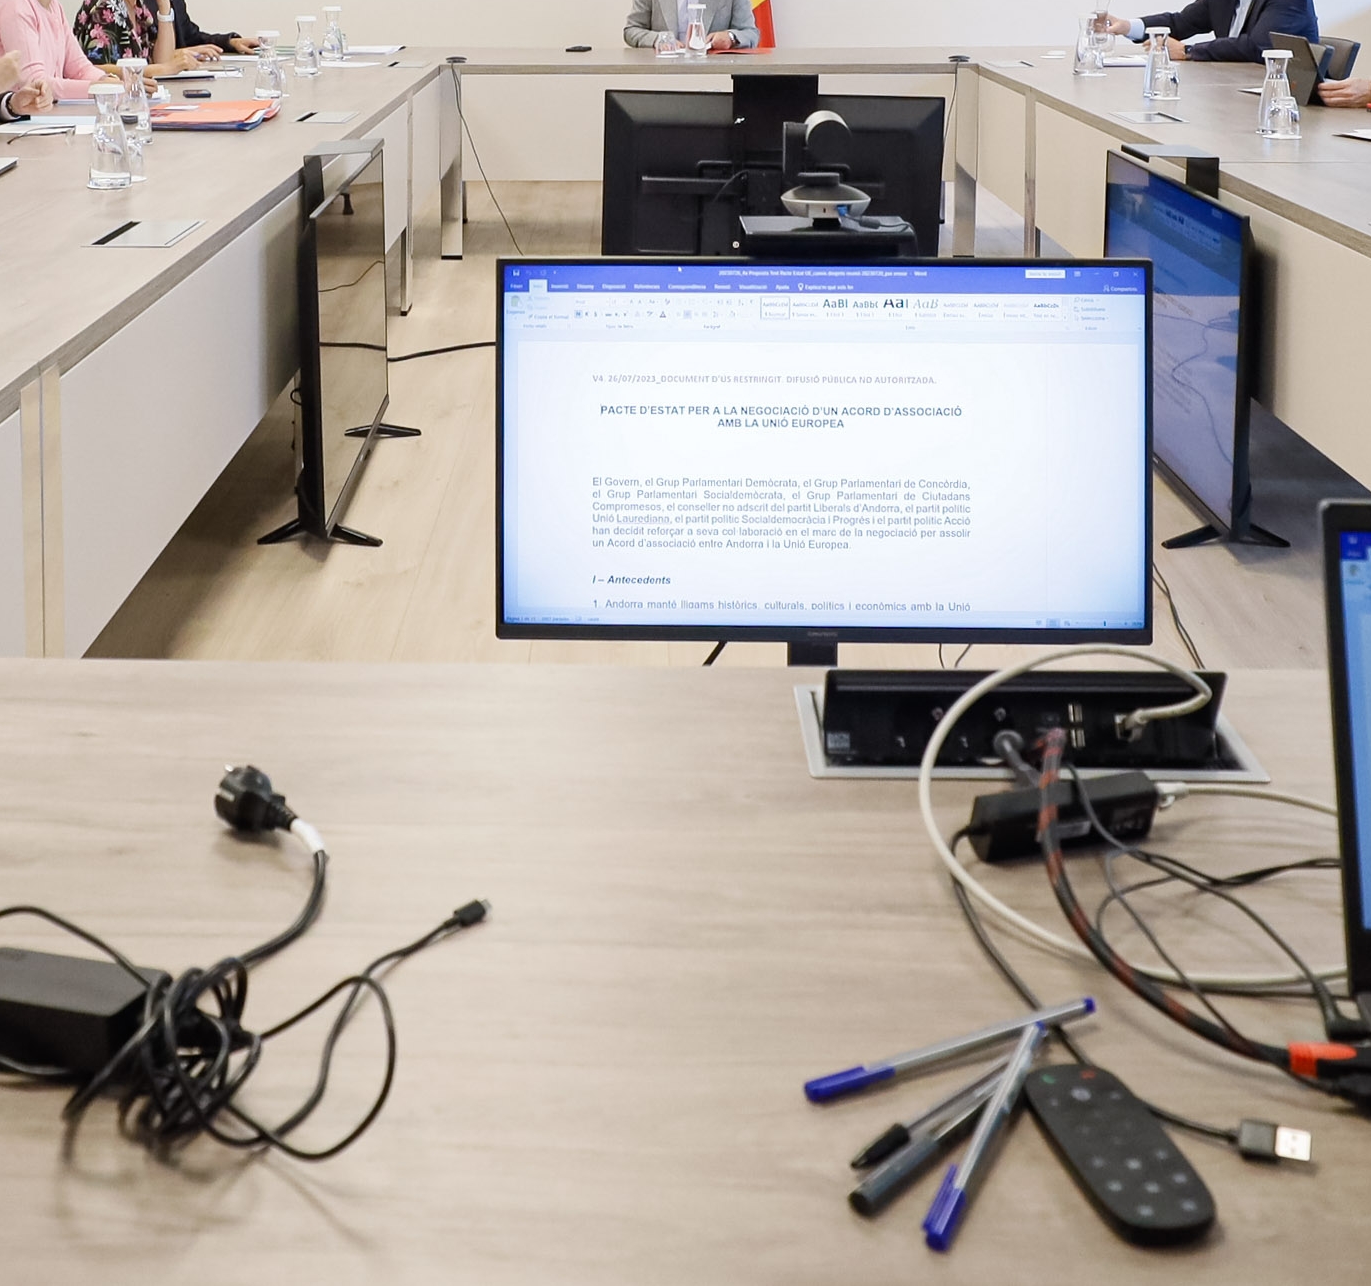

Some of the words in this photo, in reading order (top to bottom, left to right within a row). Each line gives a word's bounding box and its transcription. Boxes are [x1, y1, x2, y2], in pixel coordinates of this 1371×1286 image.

[600, 406, 636, 414] PACTE
[640, 406, 685, 414] D'ESTAT
[688, 406, 710, 415] PER
[713, 406, 720, 415] A
[724, 406, 738, 415] LA
[740, 405, 810, 415] NEGOCIACIÓ
[812, 407, 838, 415] D'UN
[841, 407, 881, 416] ACORD
[884, 406, 962, 416] D'ASSOCIACIÓ
[718, 419, 742, 427] AMB
[745, 419, 759, 427] LA
[762, 419, 789, 427] UNIÓ
[792, 419, 844, 428] EUROPEA
